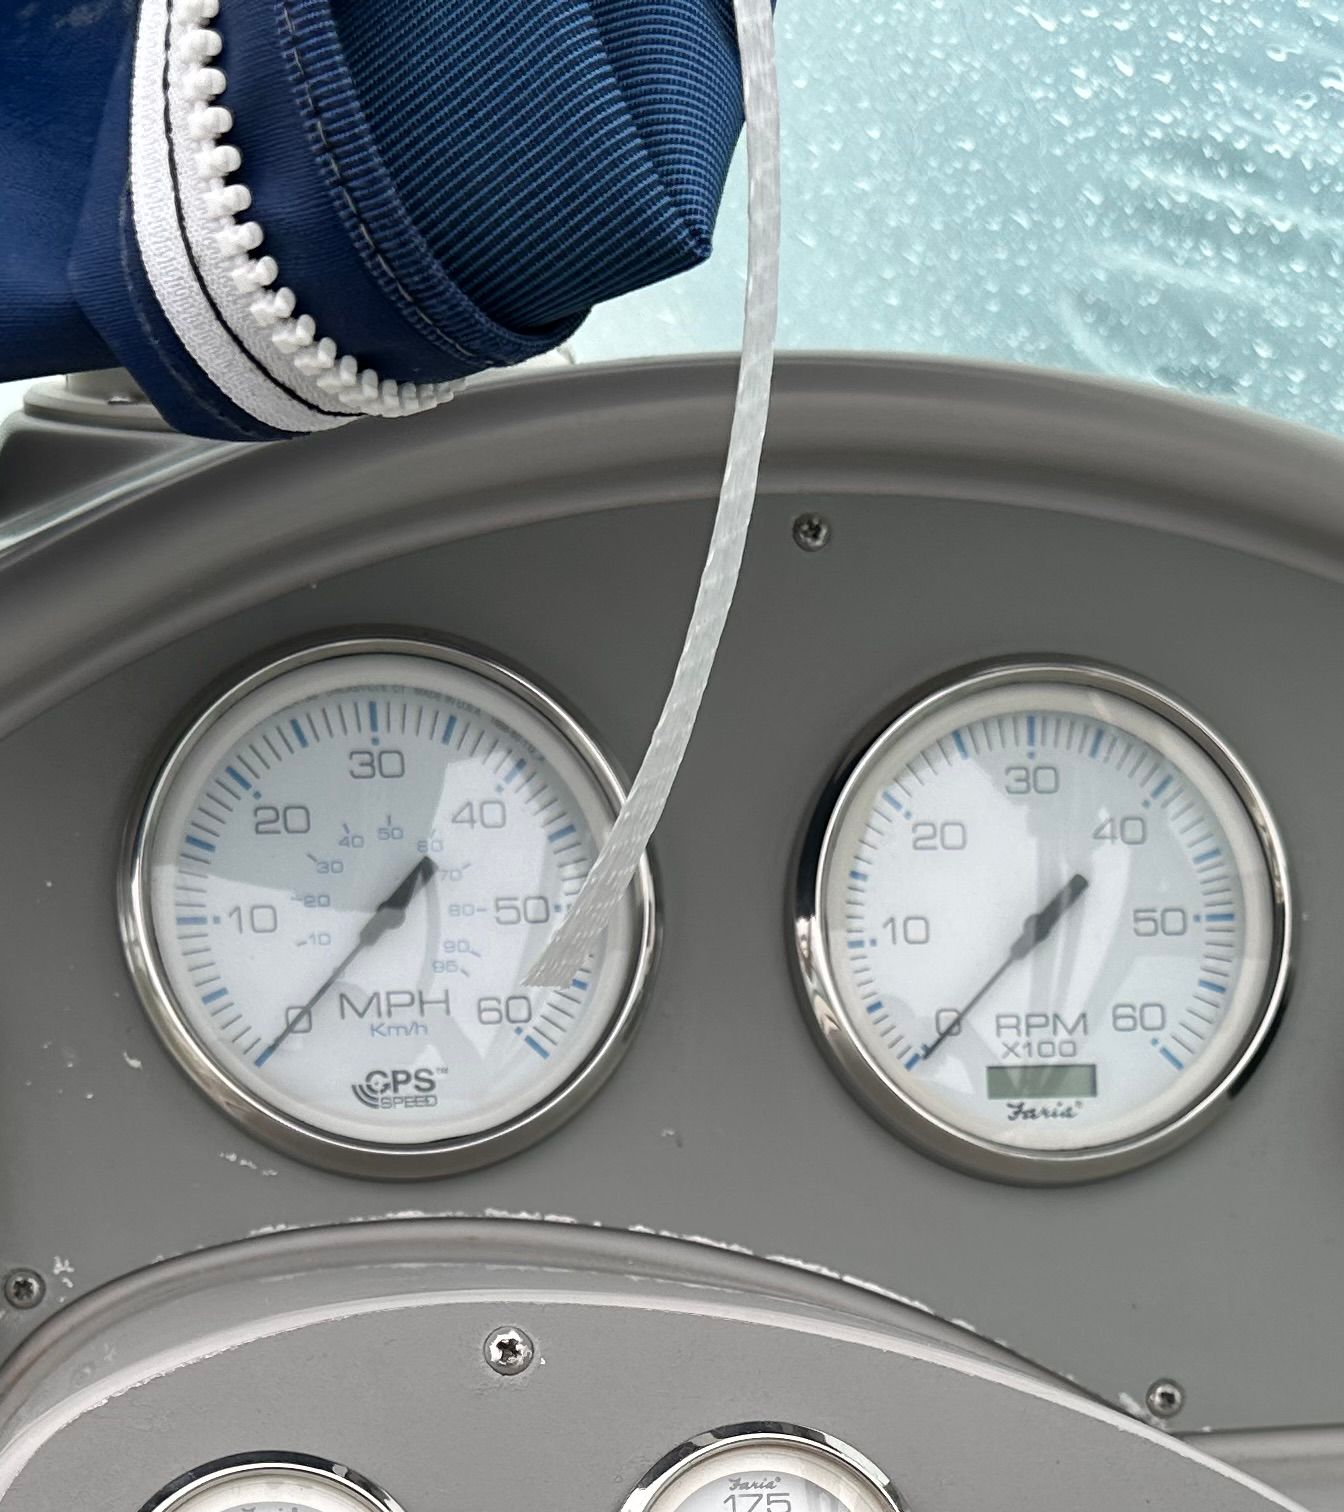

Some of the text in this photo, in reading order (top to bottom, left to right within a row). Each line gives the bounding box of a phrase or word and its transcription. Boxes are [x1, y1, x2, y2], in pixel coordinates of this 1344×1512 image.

[348, 750, 405, 780] 30
[1005, 766, 1058, 795] 30
[253, 805, 311, 835] 20
[451, 801, 507, 830] 40
[338, 835, 364, 849] 40
[377, 827, 403, 840] 50
[912, 822, 967, 851] 20
[1092, 816, 1148, 845] 40
[316, 860, 344, 874] 30
[304, 895, 330, 907] 20
[495, 895, 550, 925] 50
[227, 905, 278, 934] 10
[881, 916, 929, 945] 10
[1133, 908, 1187, 937] 50
[308, 932, 331, 945] 10
[338, 988, 452, 1020] MPH
[476, 996, 533, 1026] 60
[1112, 1003, 1165, 1032] 60
[285, 1006, 313, 1035] 0
[370, 1021, 428, 1038] Km/h
[935, 1008, 962, 1036] 0
[996, 1013, 1089, 1037] RPM
[1001, 1040, 1077, 1058] X100
[365, 1068, 436, 1094] GPS
[381, 1095, 438, 1109] SPEED
